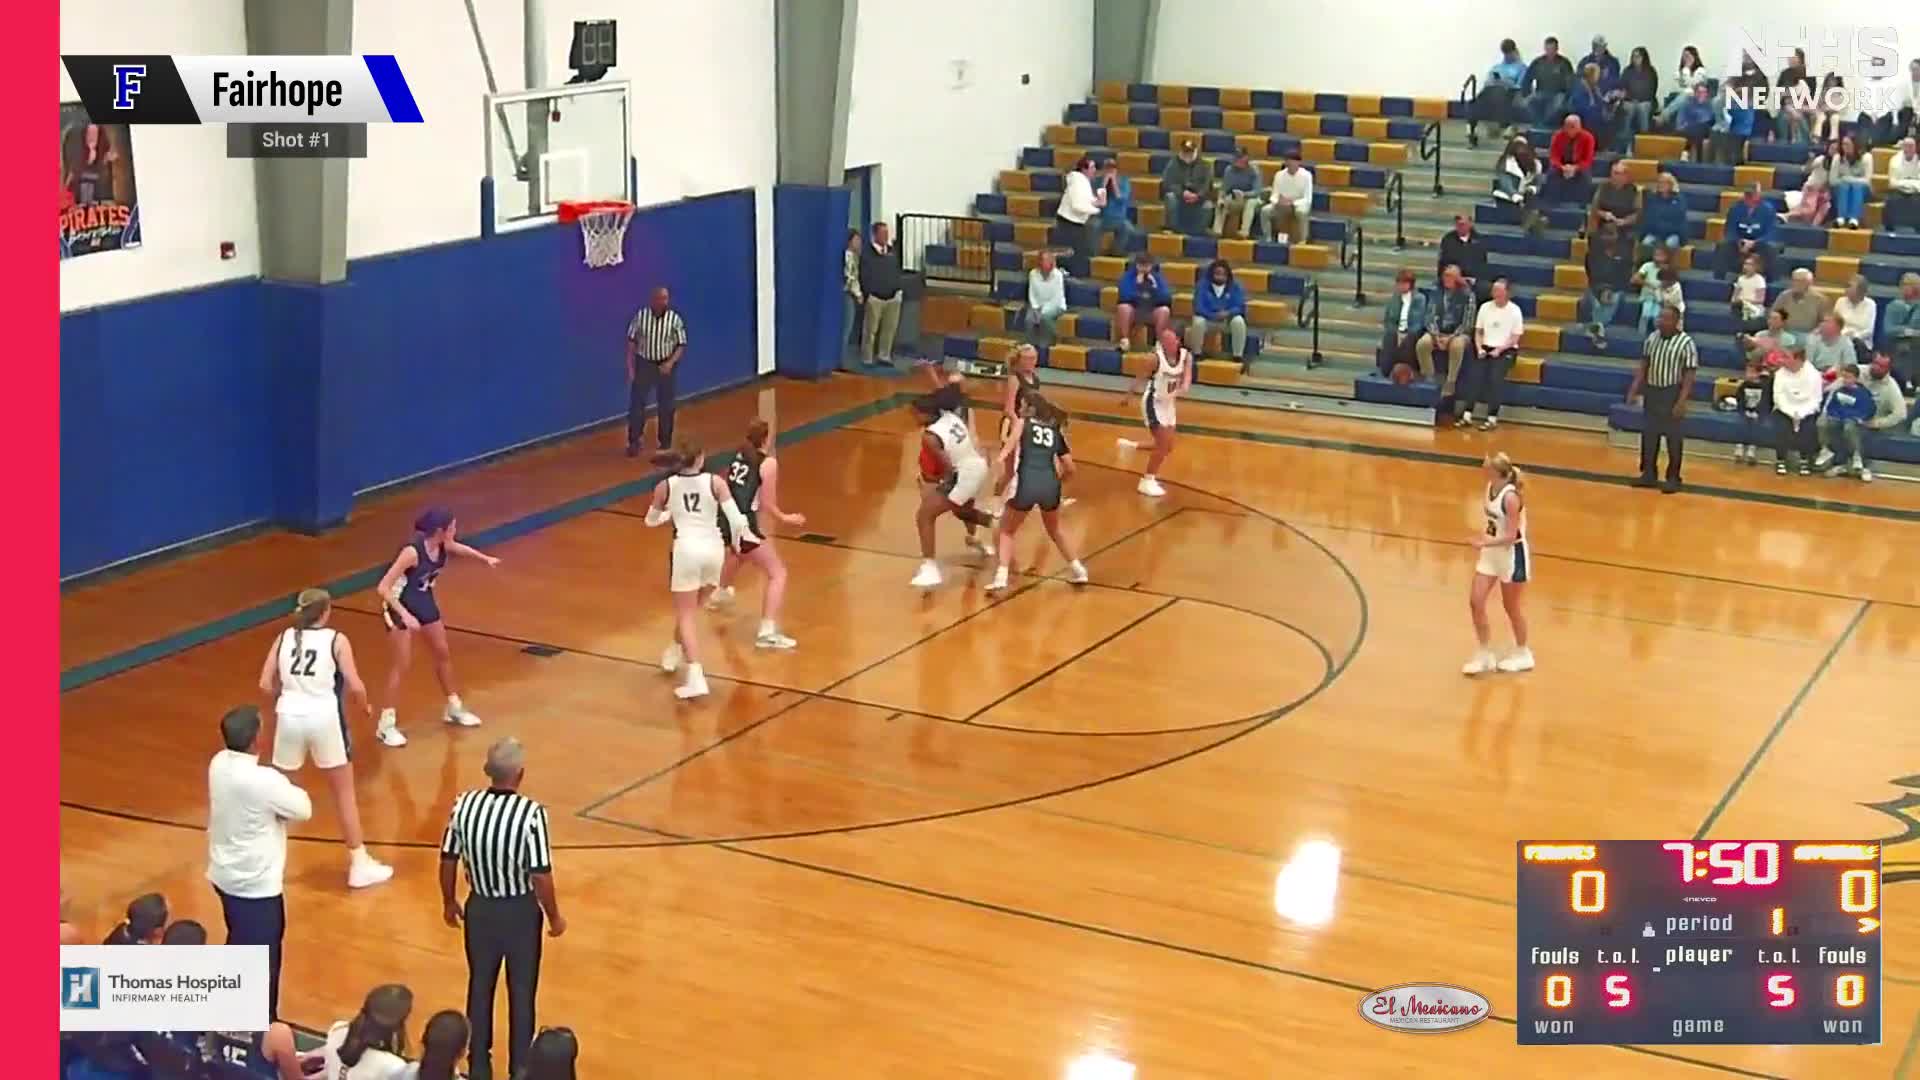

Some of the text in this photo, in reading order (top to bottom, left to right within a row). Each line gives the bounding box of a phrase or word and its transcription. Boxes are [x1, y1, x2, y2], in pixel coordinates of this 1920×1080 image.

[60, 205, 131, 233] PIRATES
[1032, 424, 1054, 448] 33
[729, 461, 749, 485] 32
[683, 492, 701, 513] 12
[290, 647, 317, 677] 22
[1662, 842, 1779, 885] 7:50
[1571, 870, 1606, 913] 0
[1841, 869, 1877, 913] 0
[1666, 913, 1733, 935] period
[1771, 907, 1784, 936] 1
[1531, 946, 1580, 965] fouls
[1666, 945, 1733, 966] player
[1818, 946, 1867, 964] fouls
[1546, 975, 1572, 1007] 0
[1605, 975, 1631, 1007] 5
[1767, 974, 1795, 1007] 5
[1836, 974, 1865, 1007] 0
[1535, 1020, 1574, 1034] won
[1672, 1019, 1725, 1037] game
[1823, 1019, 1863, 1034] won
